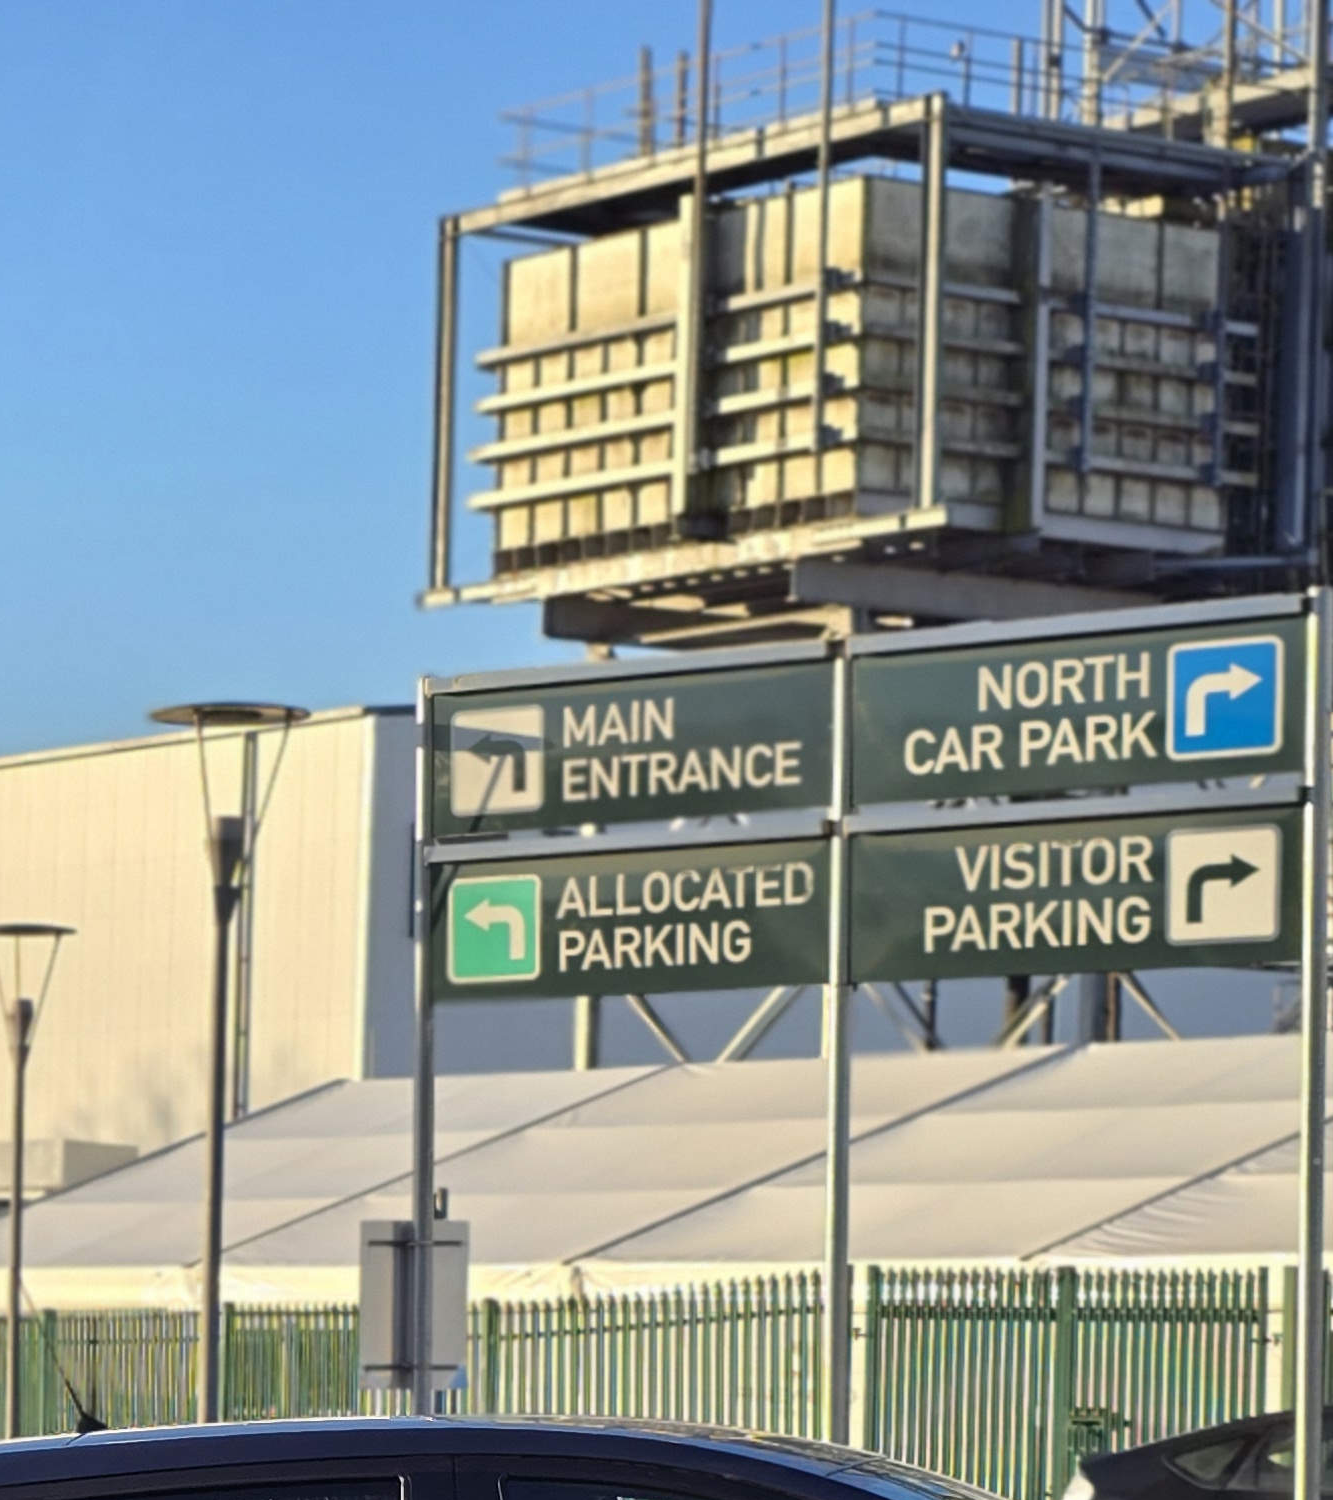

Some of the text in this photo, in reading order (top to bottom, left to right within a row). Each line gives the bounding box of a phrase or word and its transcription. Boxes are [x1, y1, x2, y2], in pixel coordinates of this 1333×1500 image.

[977, 651, 1150, 712] NORTH
[562, 697, 674, 748] MAIN
[904, 710, 1158, 776] CAR PARK
[562, 741, 802, 802] ENTRANCE
[556, 861, 815, 920] ALLOCATED
[955, 835, 1154, 892] VISITOR
[558, 919, 752, 973] PARKING
[924, 895, 1152, 954] PARKING
